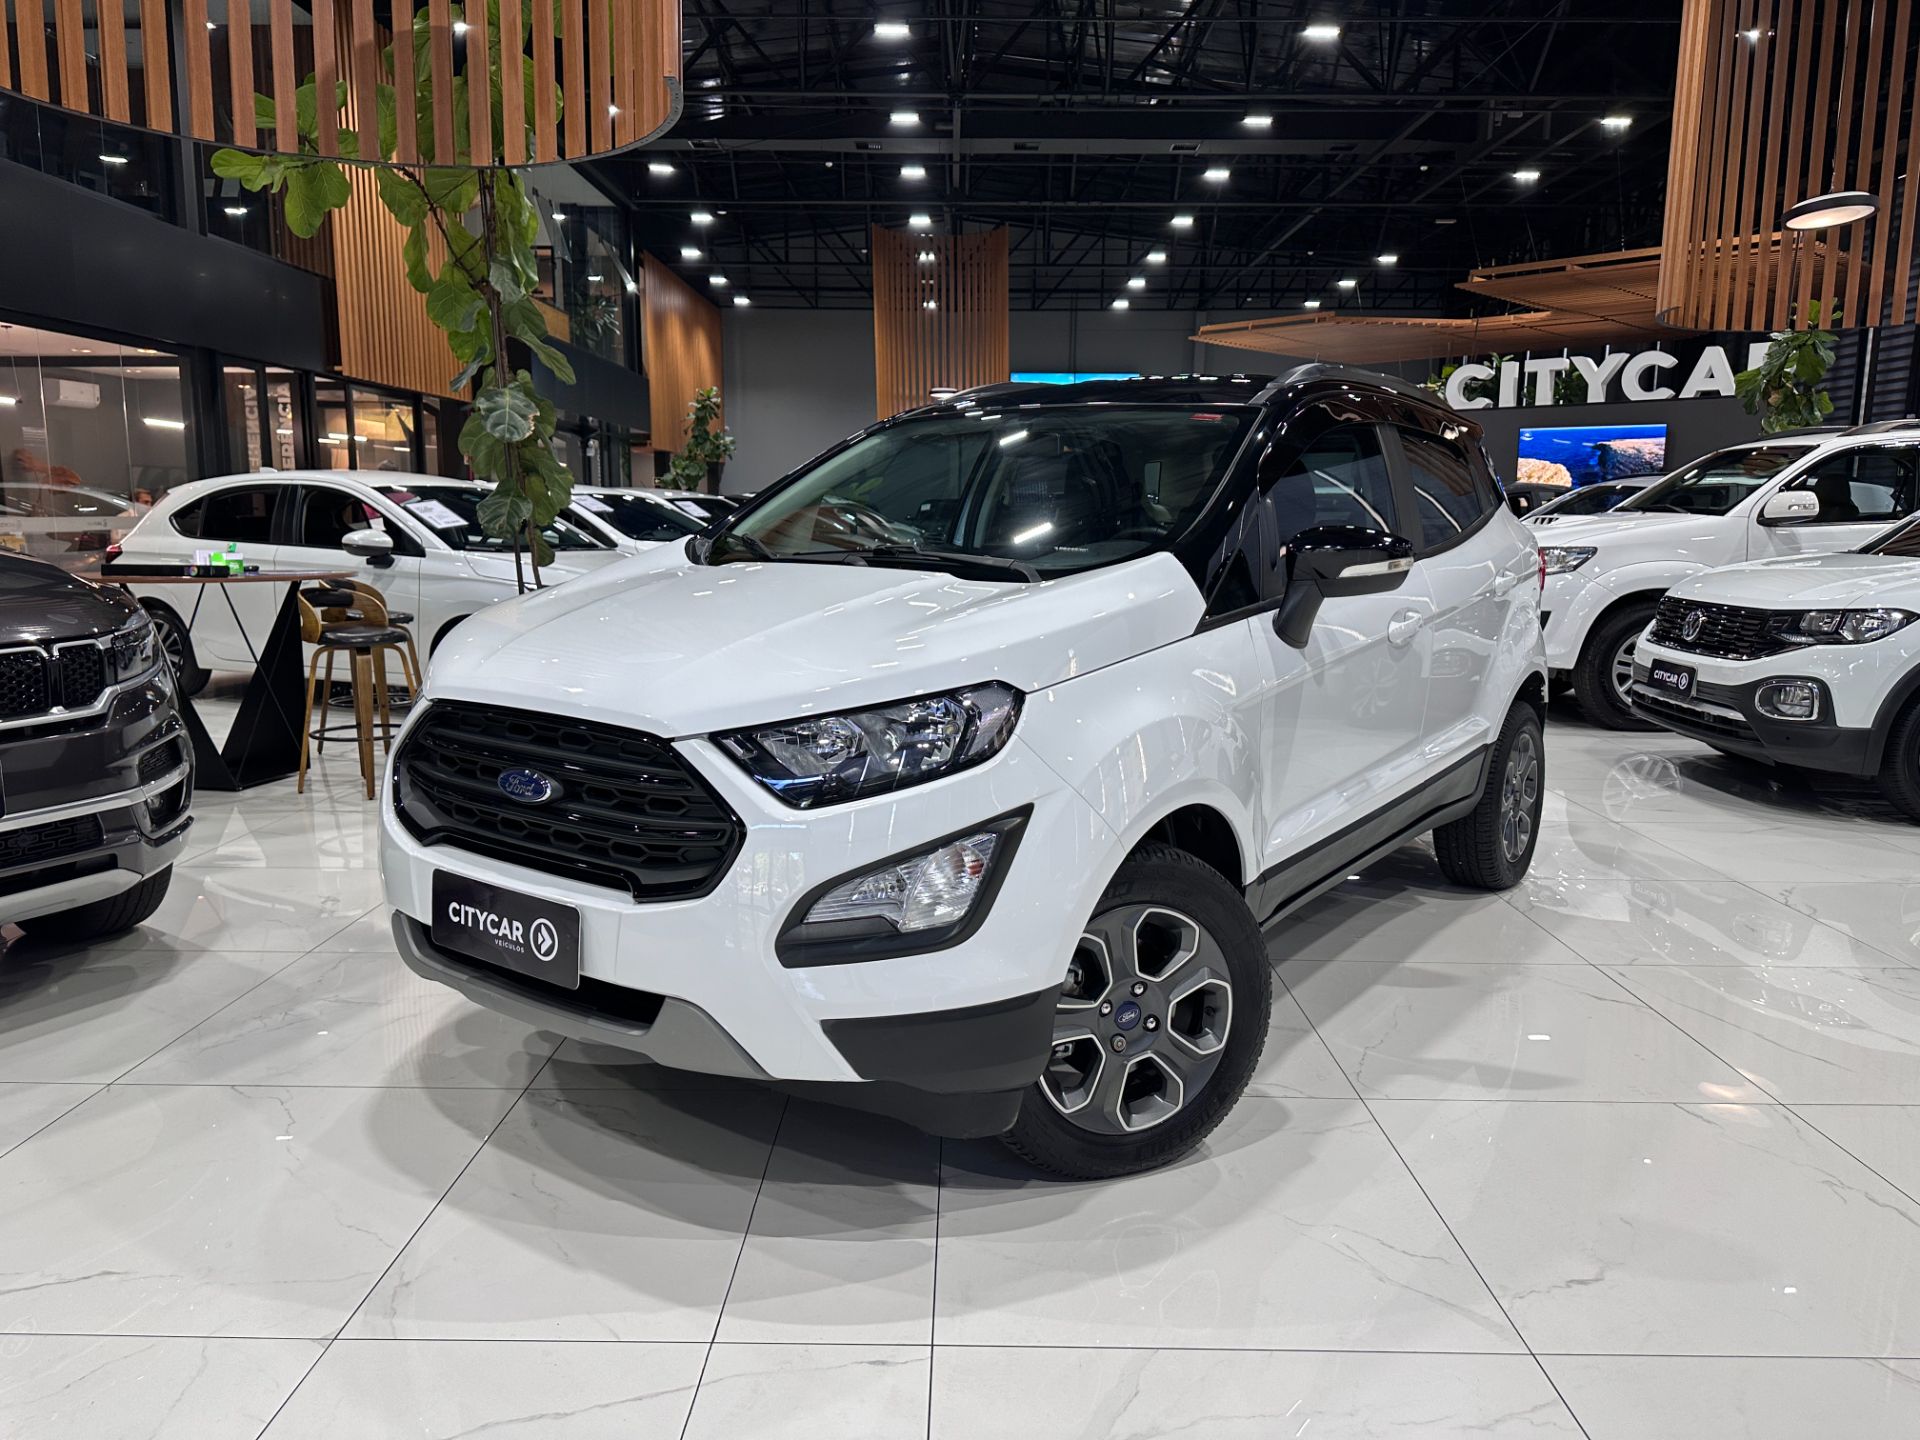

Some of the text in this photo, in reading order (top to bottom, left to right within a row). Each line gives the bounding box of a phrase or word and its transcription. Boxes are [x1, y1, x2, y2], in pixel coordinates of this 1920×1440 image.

[1445, 341, 1797, 411] CITYCA
[1653, 669, 1678, 684] CITYCAR
[448, 901, 524, 944] CITYCAR
